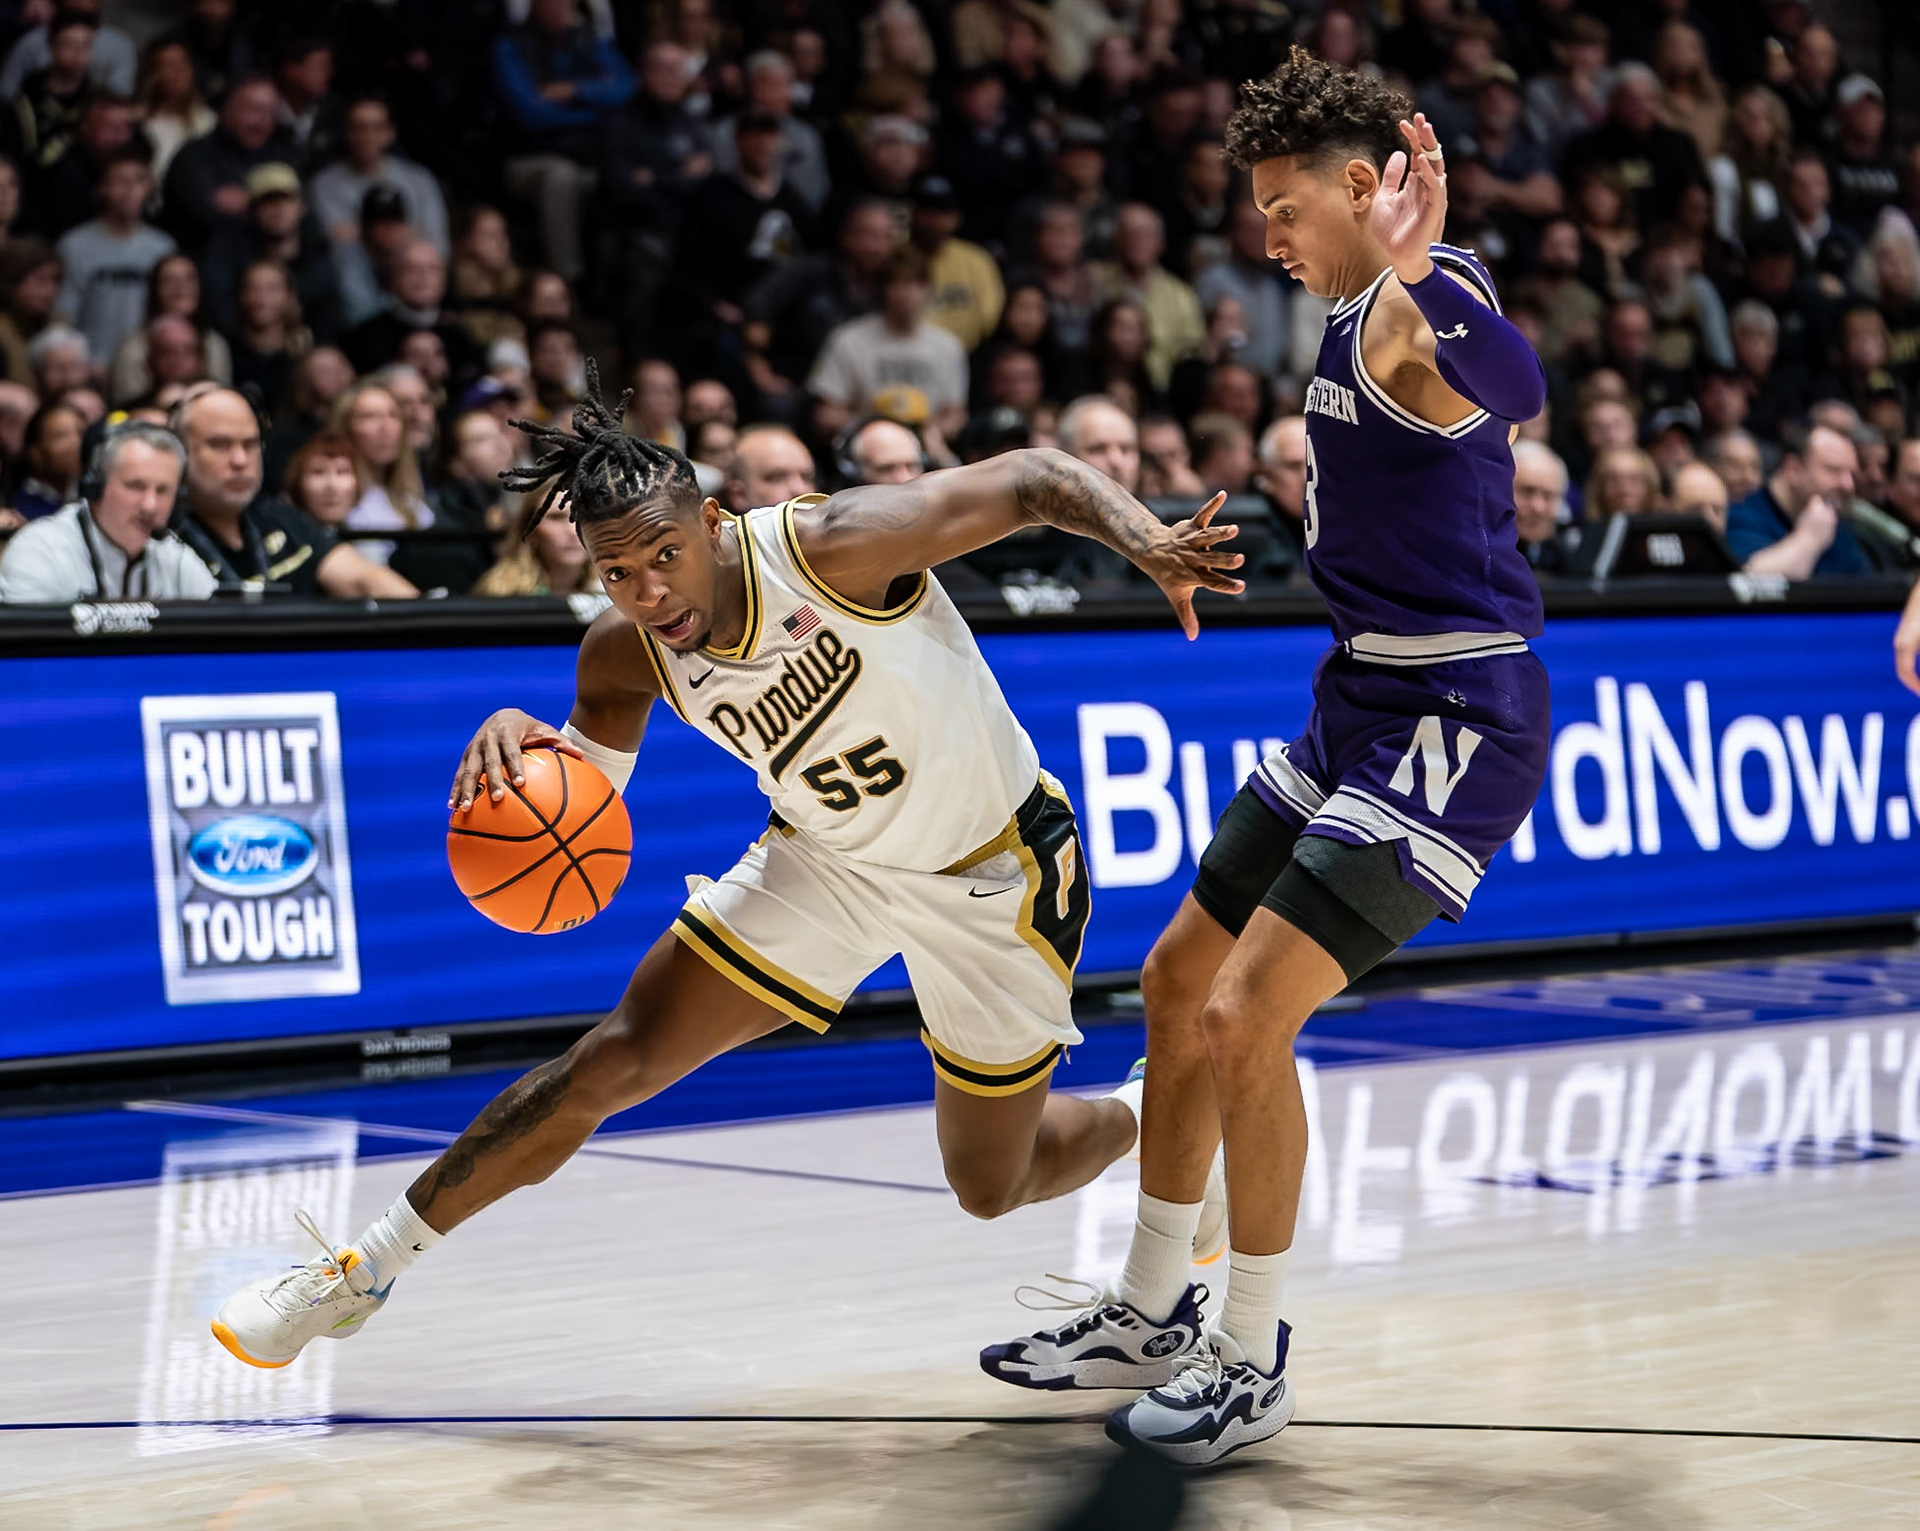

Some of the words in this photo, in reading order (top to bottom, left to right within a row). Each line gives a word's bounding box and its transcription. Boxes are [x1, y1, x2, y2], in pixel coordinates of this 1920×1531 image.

[706, 628, 864, 761] Purdue
[169, 728, 318, 808] BUILT
[798, 735, 908, 813] 55
[1388, 715, 1483, 818] N
[214, 837, 287, 873] Ford
[1054, 834, 1077, 921] P
[183, 897, 334, 965] TOUGH
